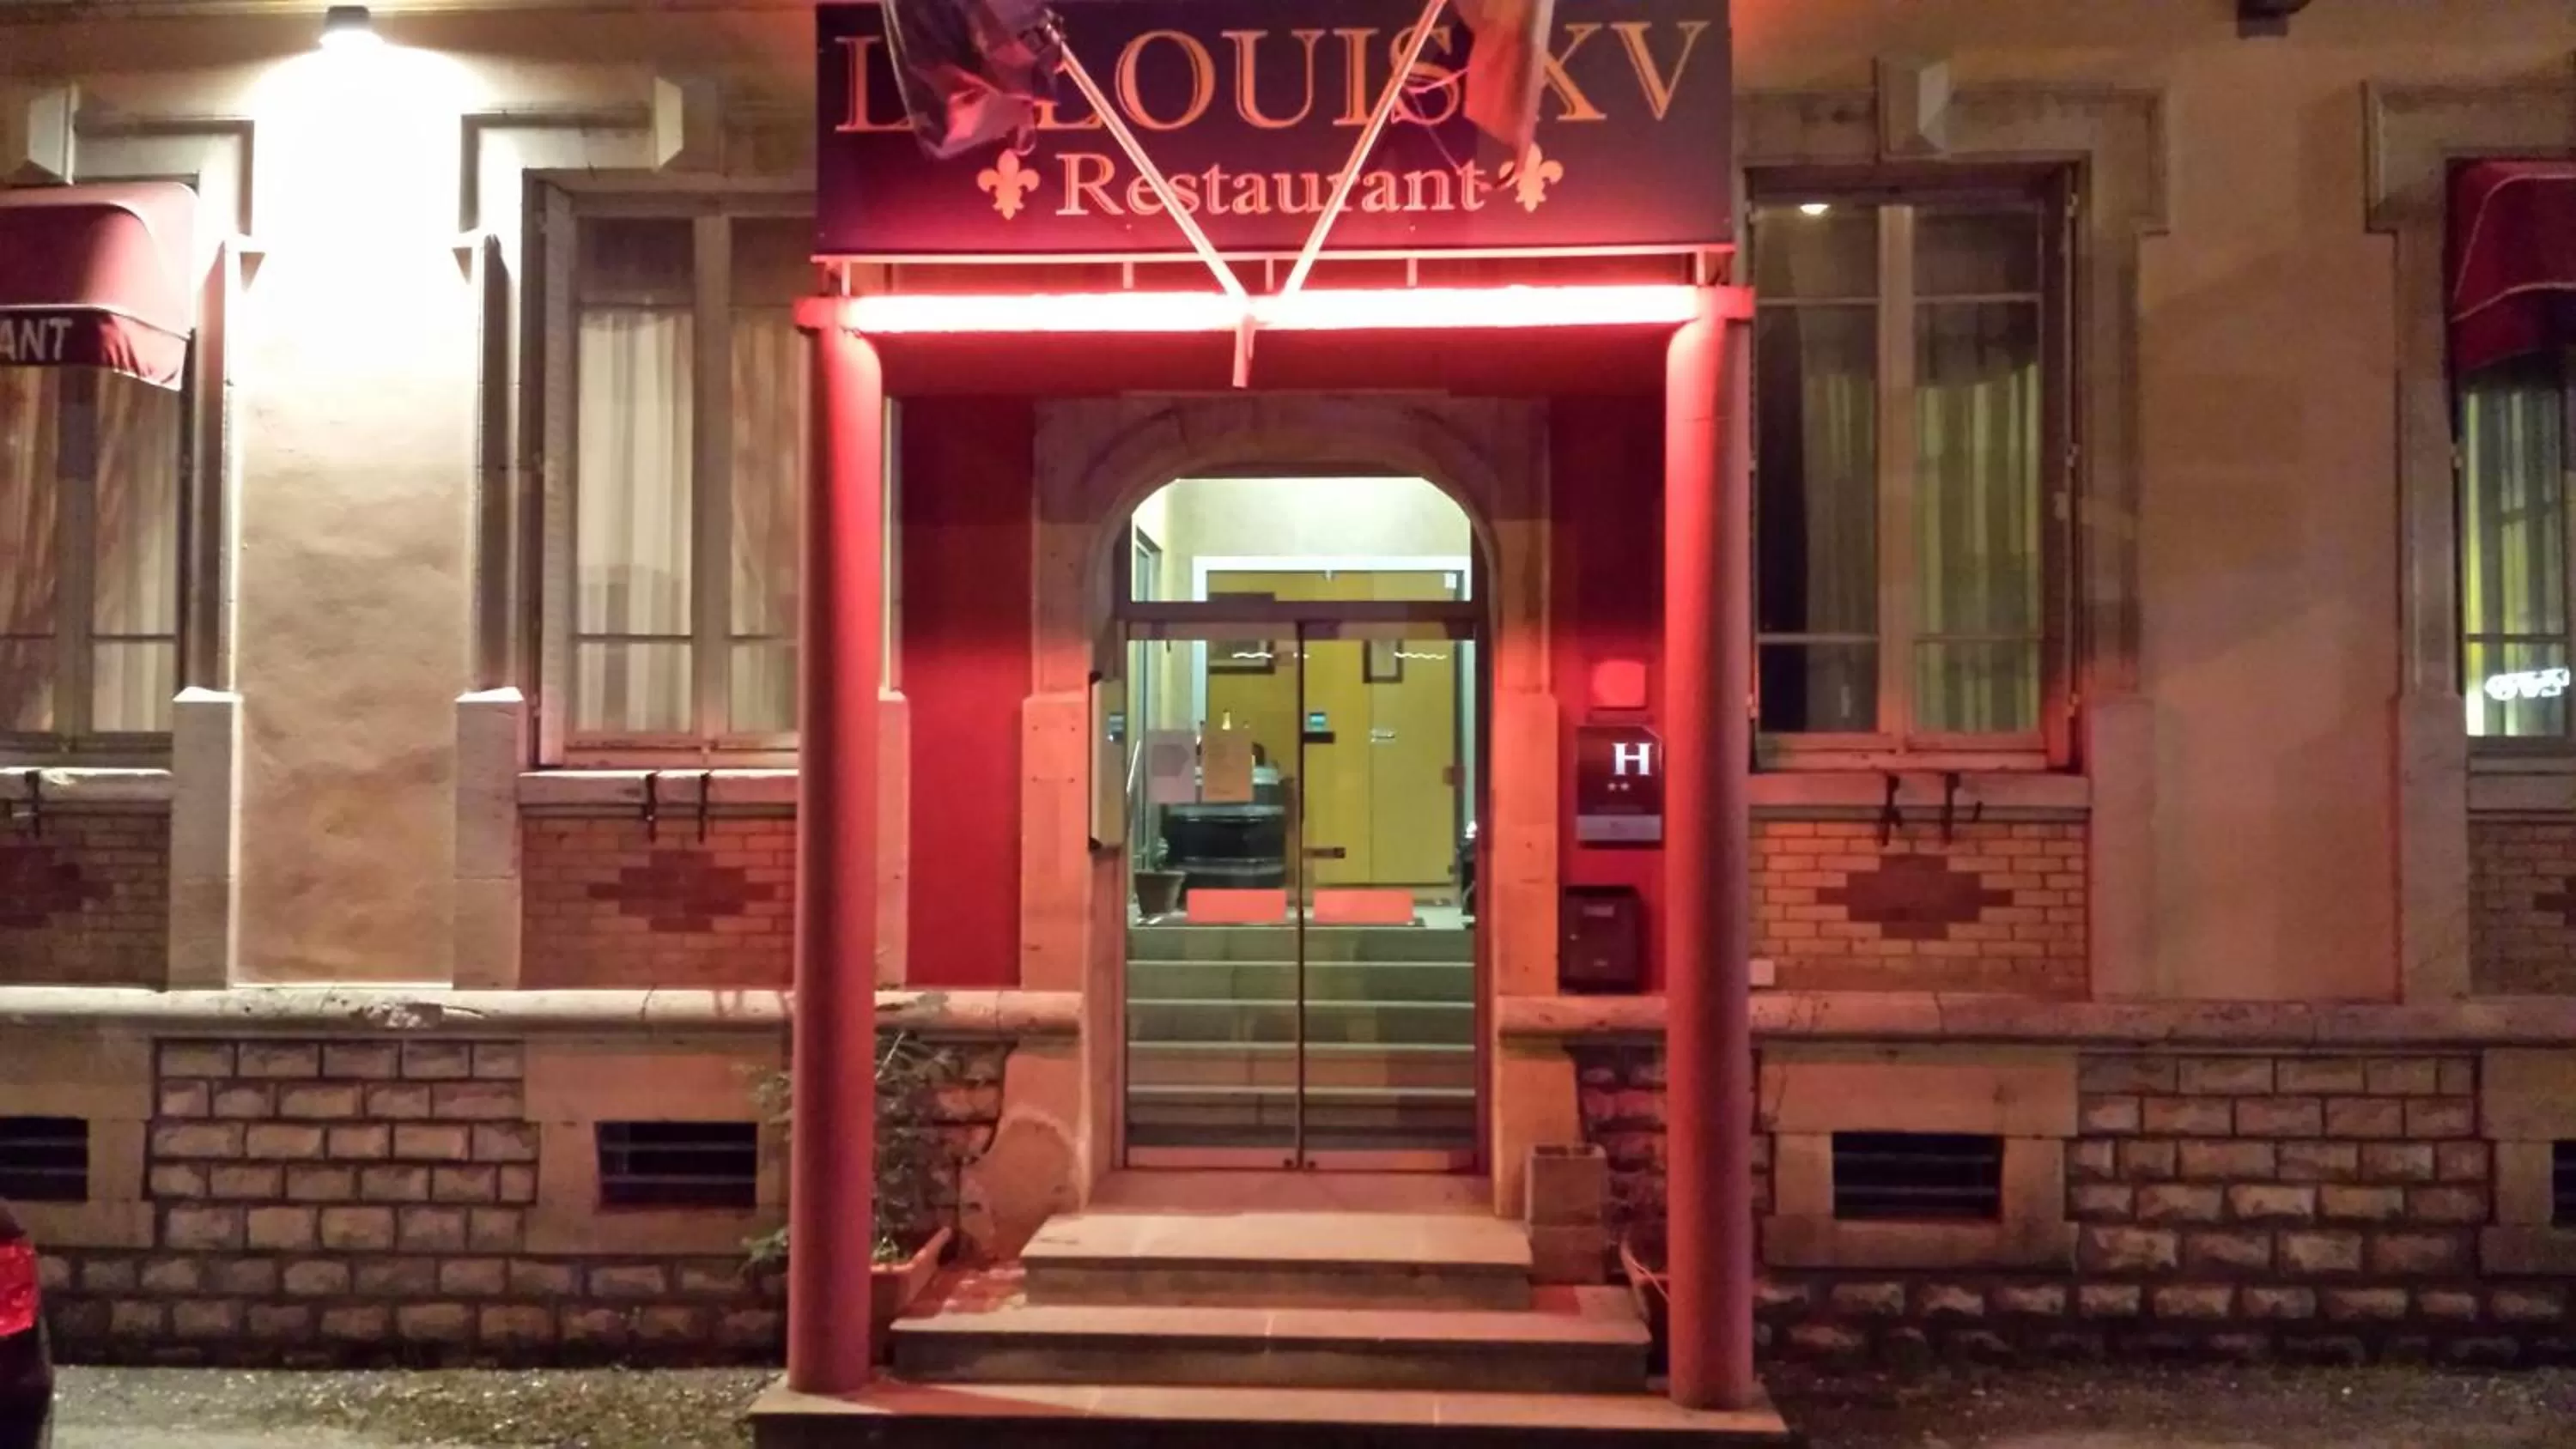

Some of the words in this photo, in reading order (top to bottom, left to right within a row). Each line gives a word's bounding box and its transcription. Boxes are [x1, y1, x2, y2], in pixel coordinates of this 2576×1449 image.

[1537, 20, 1710, 121] XV
[1054, 152, 1488, 216] Restaurant
[1613, 743, 1653, 775] H
